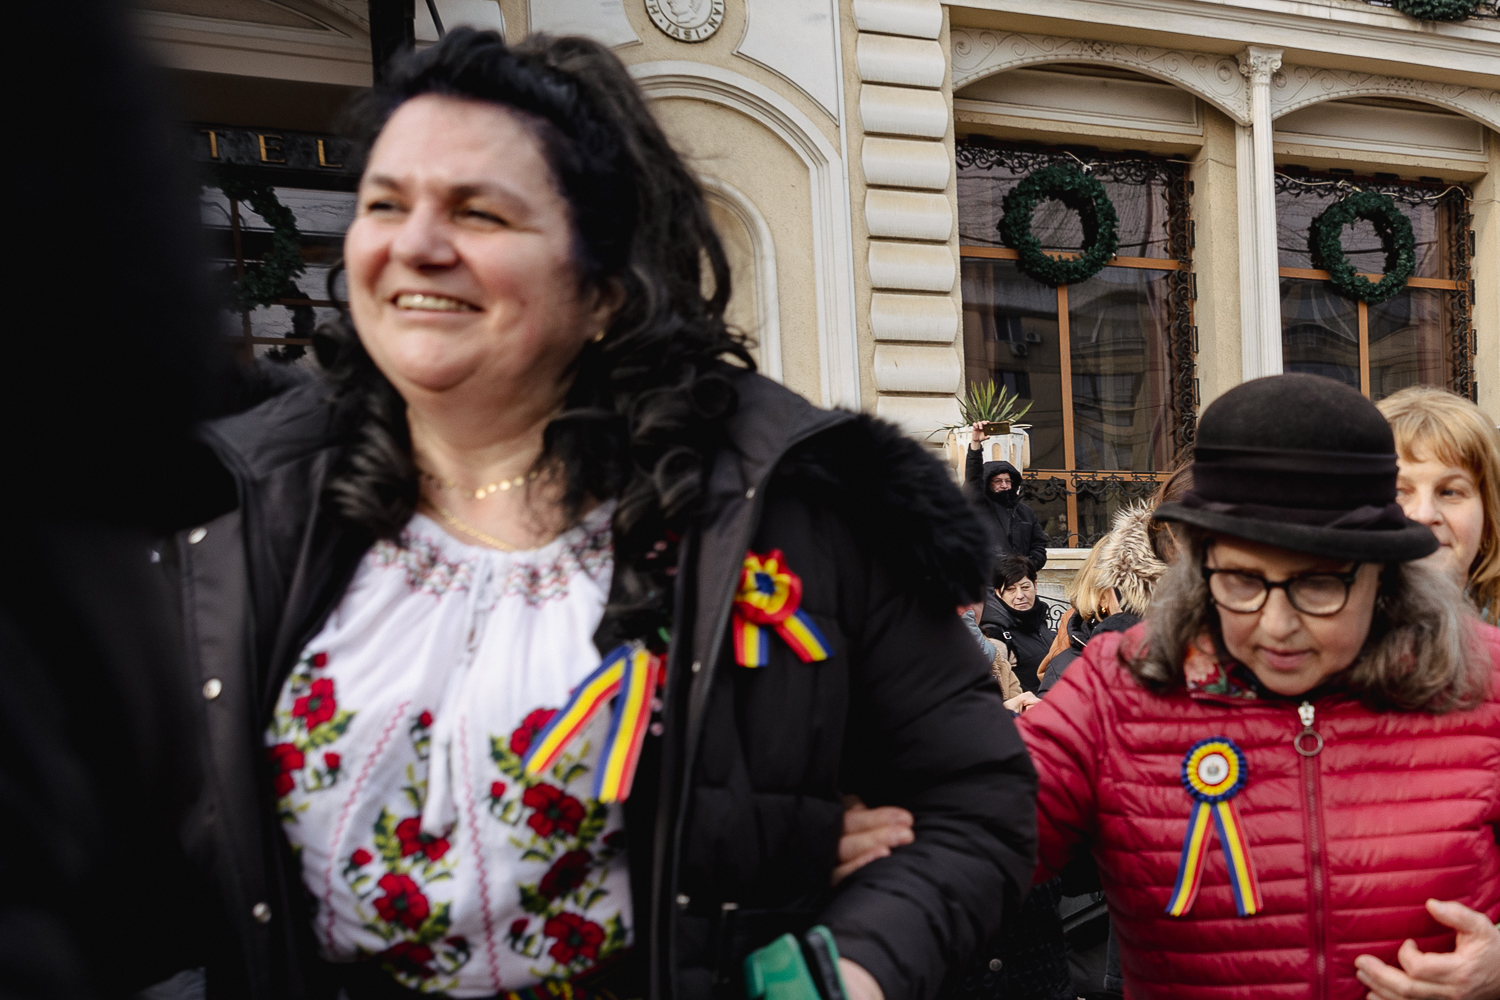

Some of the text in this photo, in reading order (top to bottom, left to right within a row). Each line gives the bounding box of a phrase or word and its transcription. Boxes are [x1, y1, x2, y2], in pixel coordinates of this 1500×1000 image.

[665, 0, 723, 40] IAN IASI
[199, 129, 343, 168] TEL
